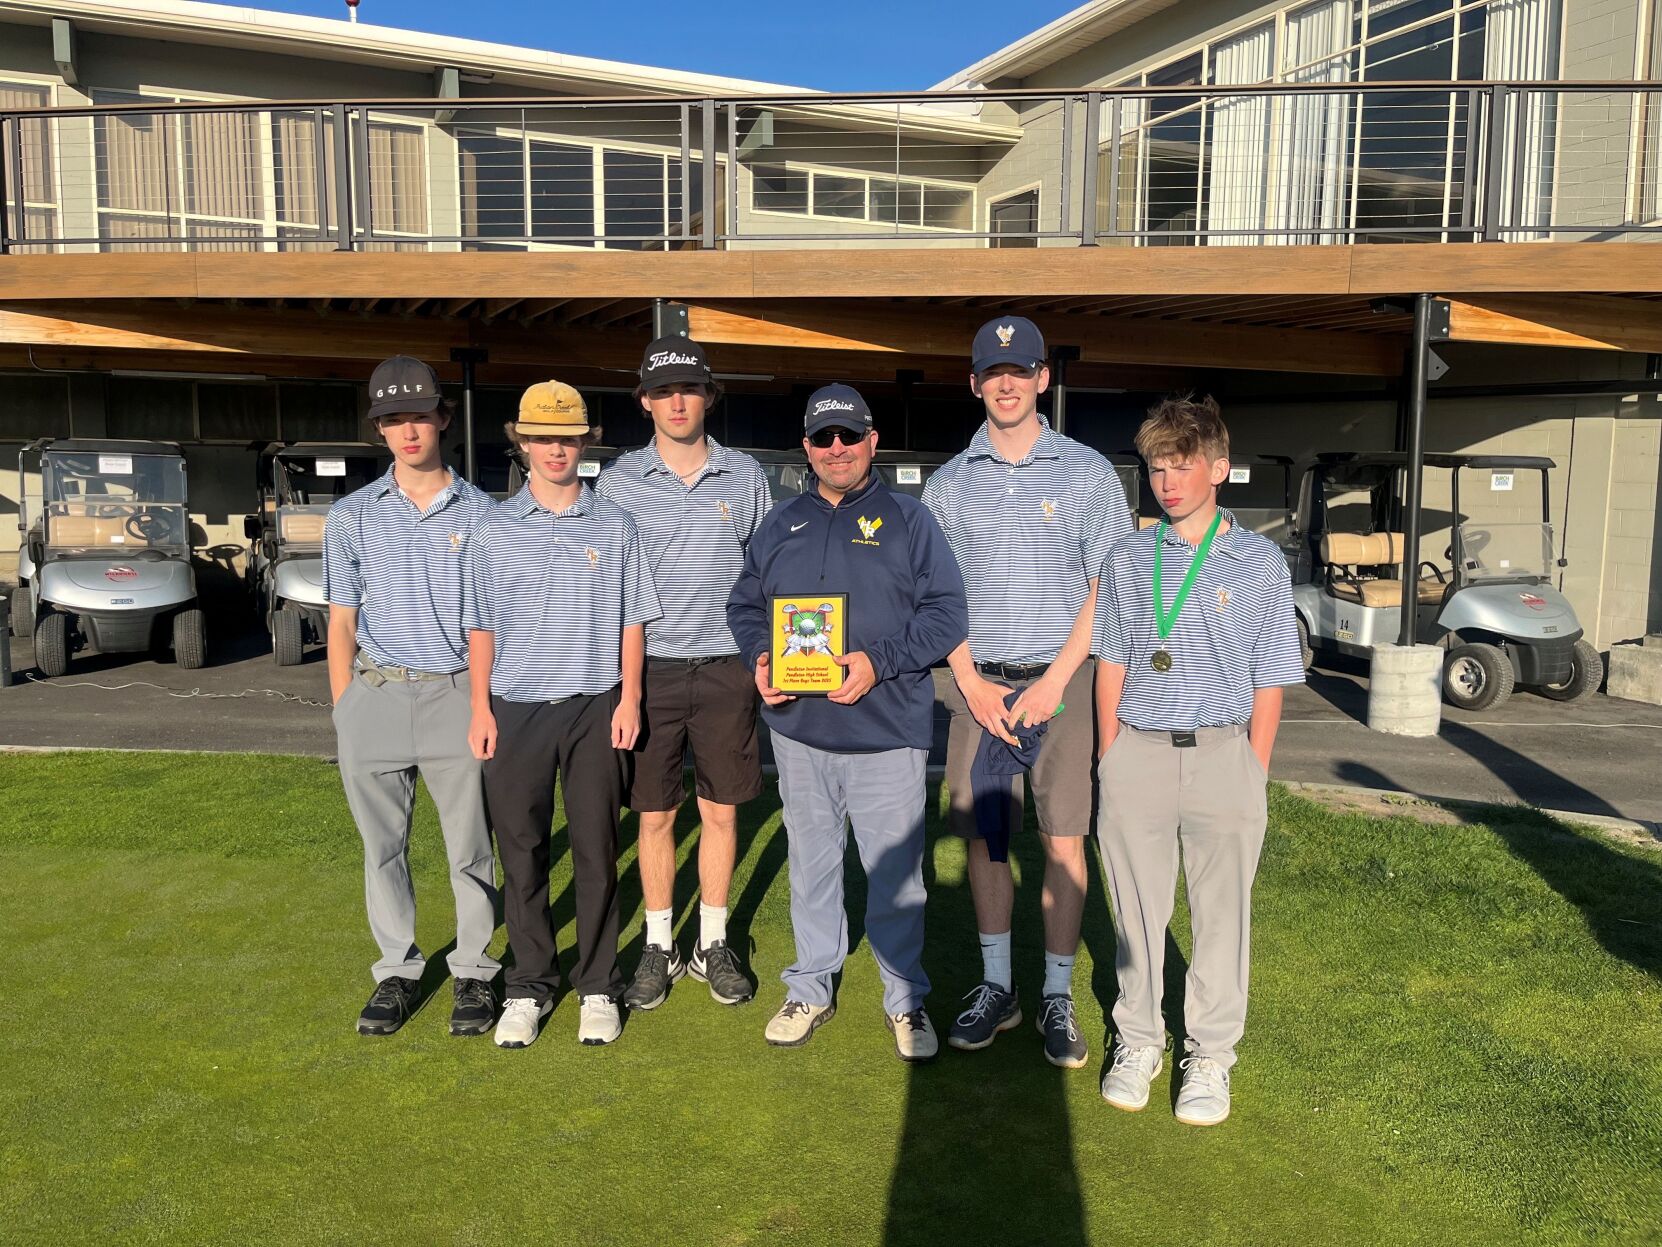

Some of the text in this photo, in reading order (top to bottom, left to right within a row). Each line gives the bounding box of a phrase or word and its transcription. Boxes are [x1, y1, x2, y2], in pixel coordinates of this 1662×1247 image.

[647, 350, 698, 371] Titleist
[812, 399, 855, 416] Titleist
[851, 538, 880, 546] ATHLETICS
[1339, 619, 1349, 631] 14
